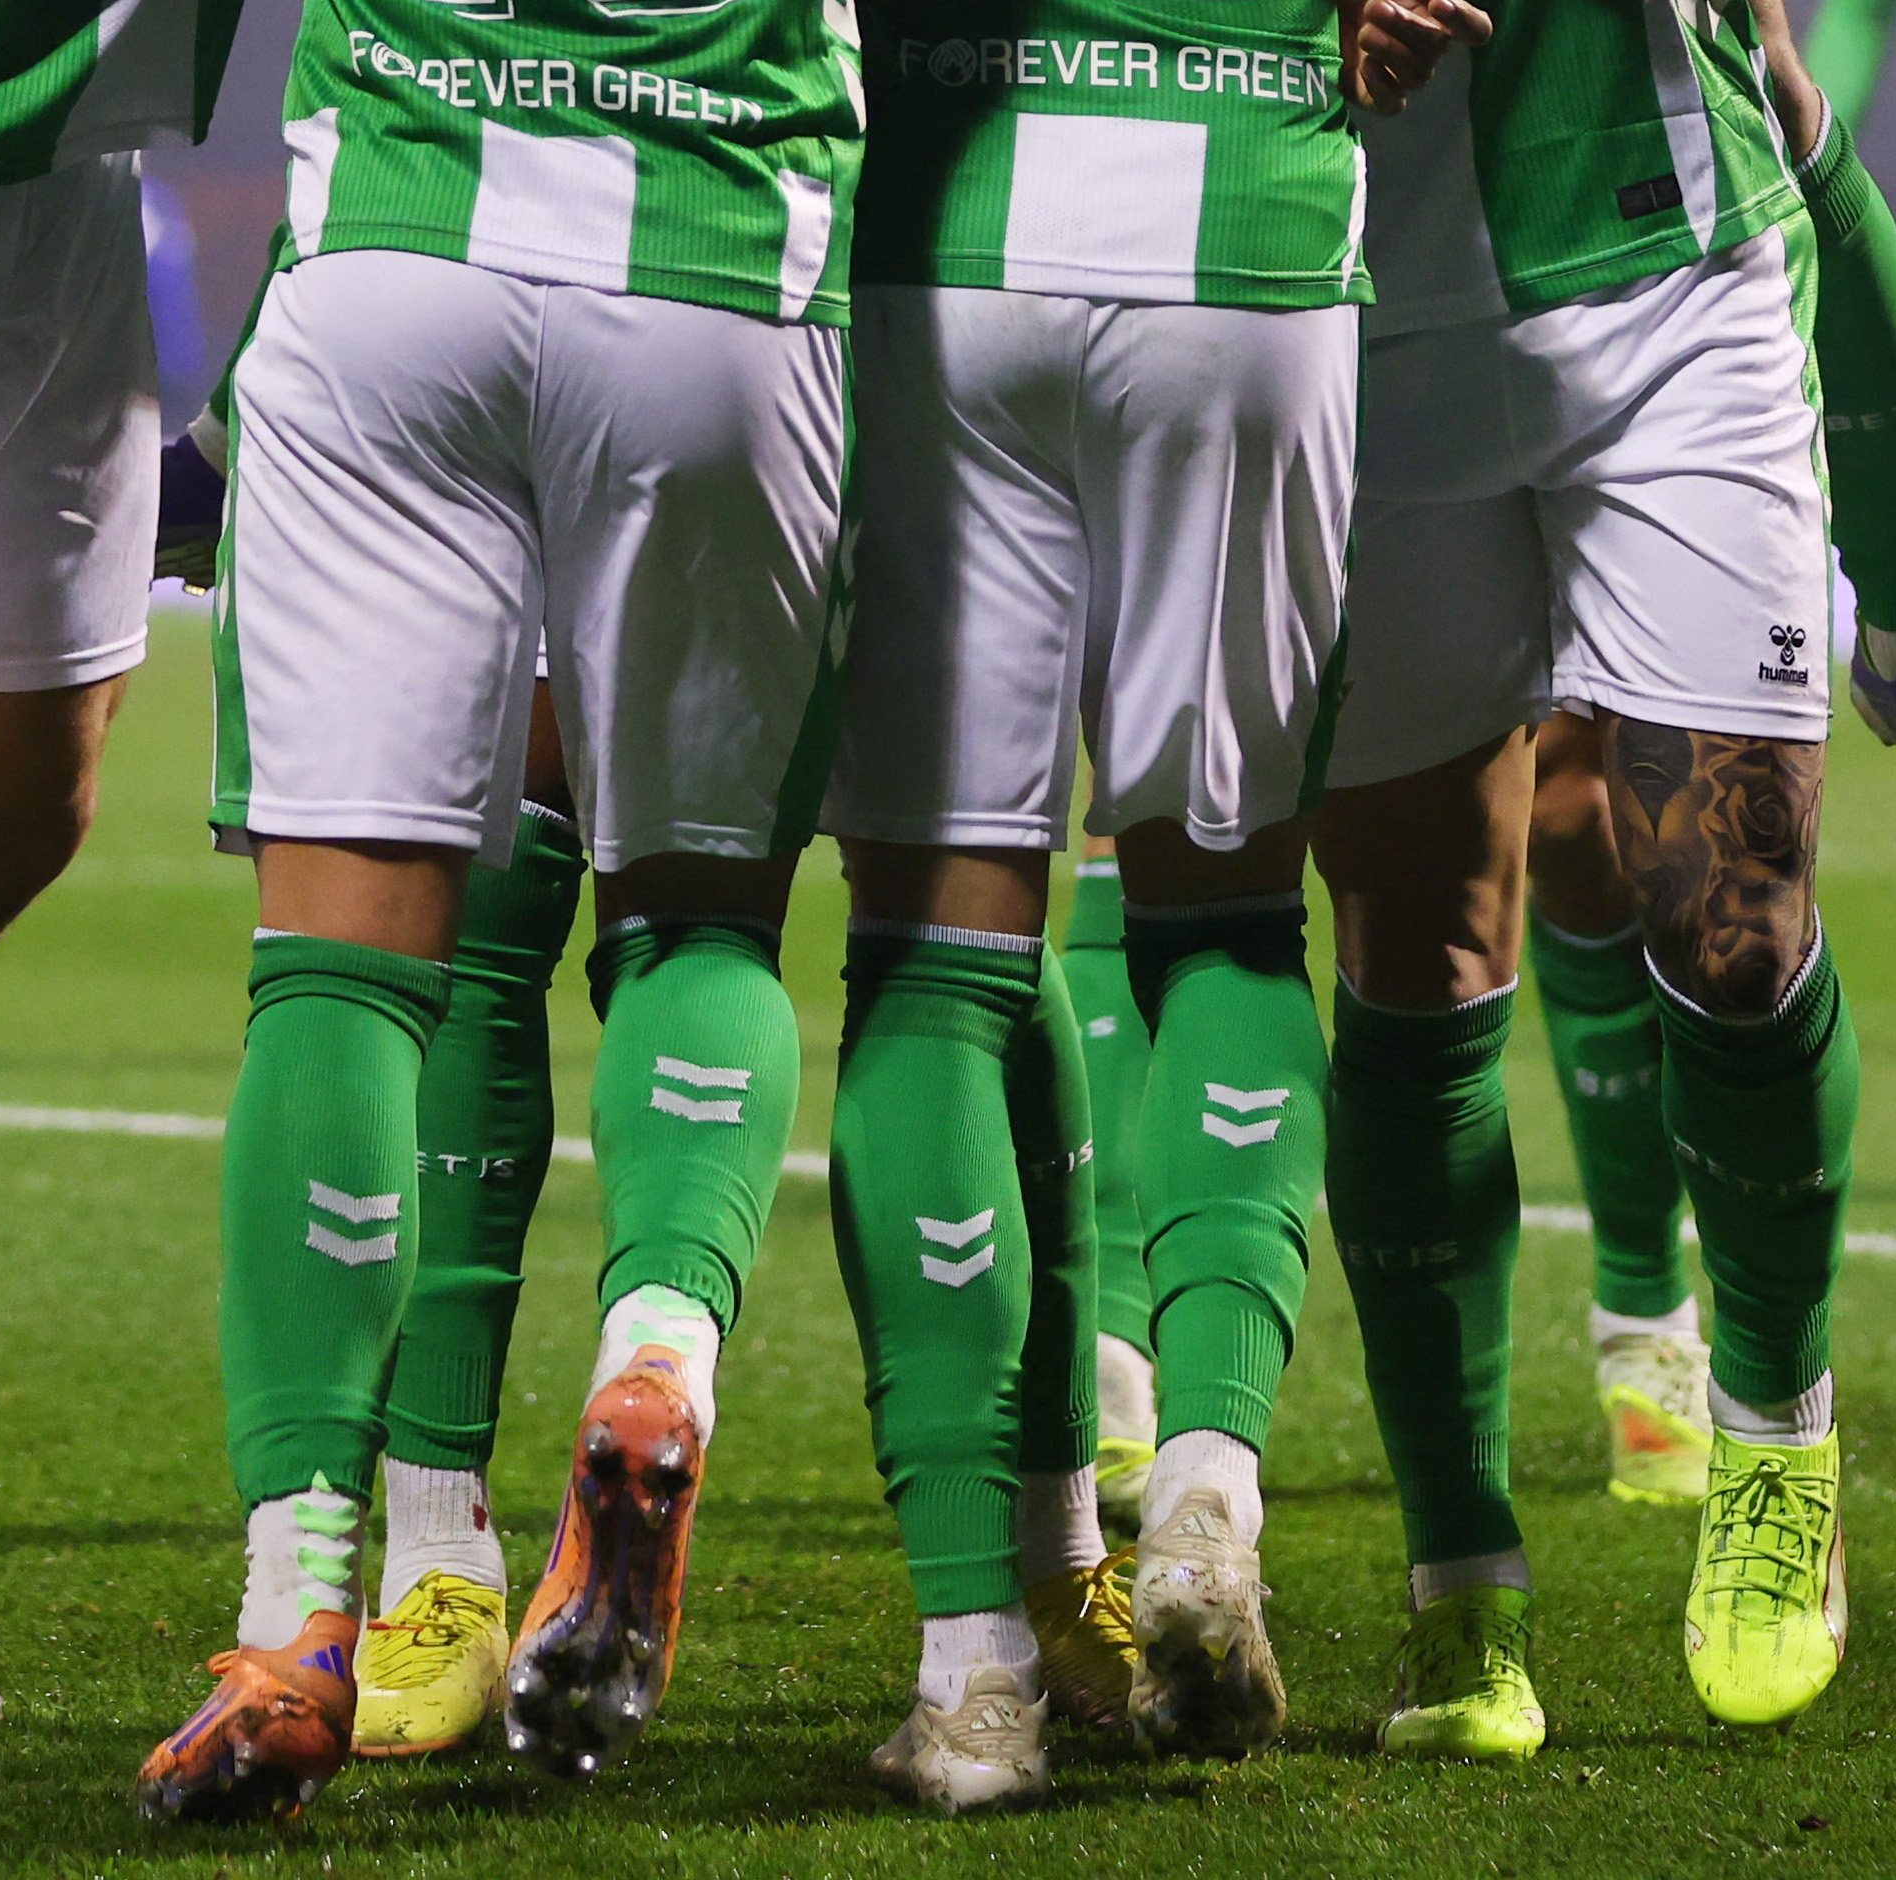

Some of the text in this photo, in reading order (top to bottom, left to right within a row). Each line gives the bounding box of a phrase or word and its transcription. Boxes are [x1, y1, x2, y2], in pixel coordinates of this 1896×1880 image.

[348, 30, 764, 131] FOREVER GREEN
[900, 37, 1329, 111] FOREVER GREEN
[1758, 661, 1808, 685] hummel
